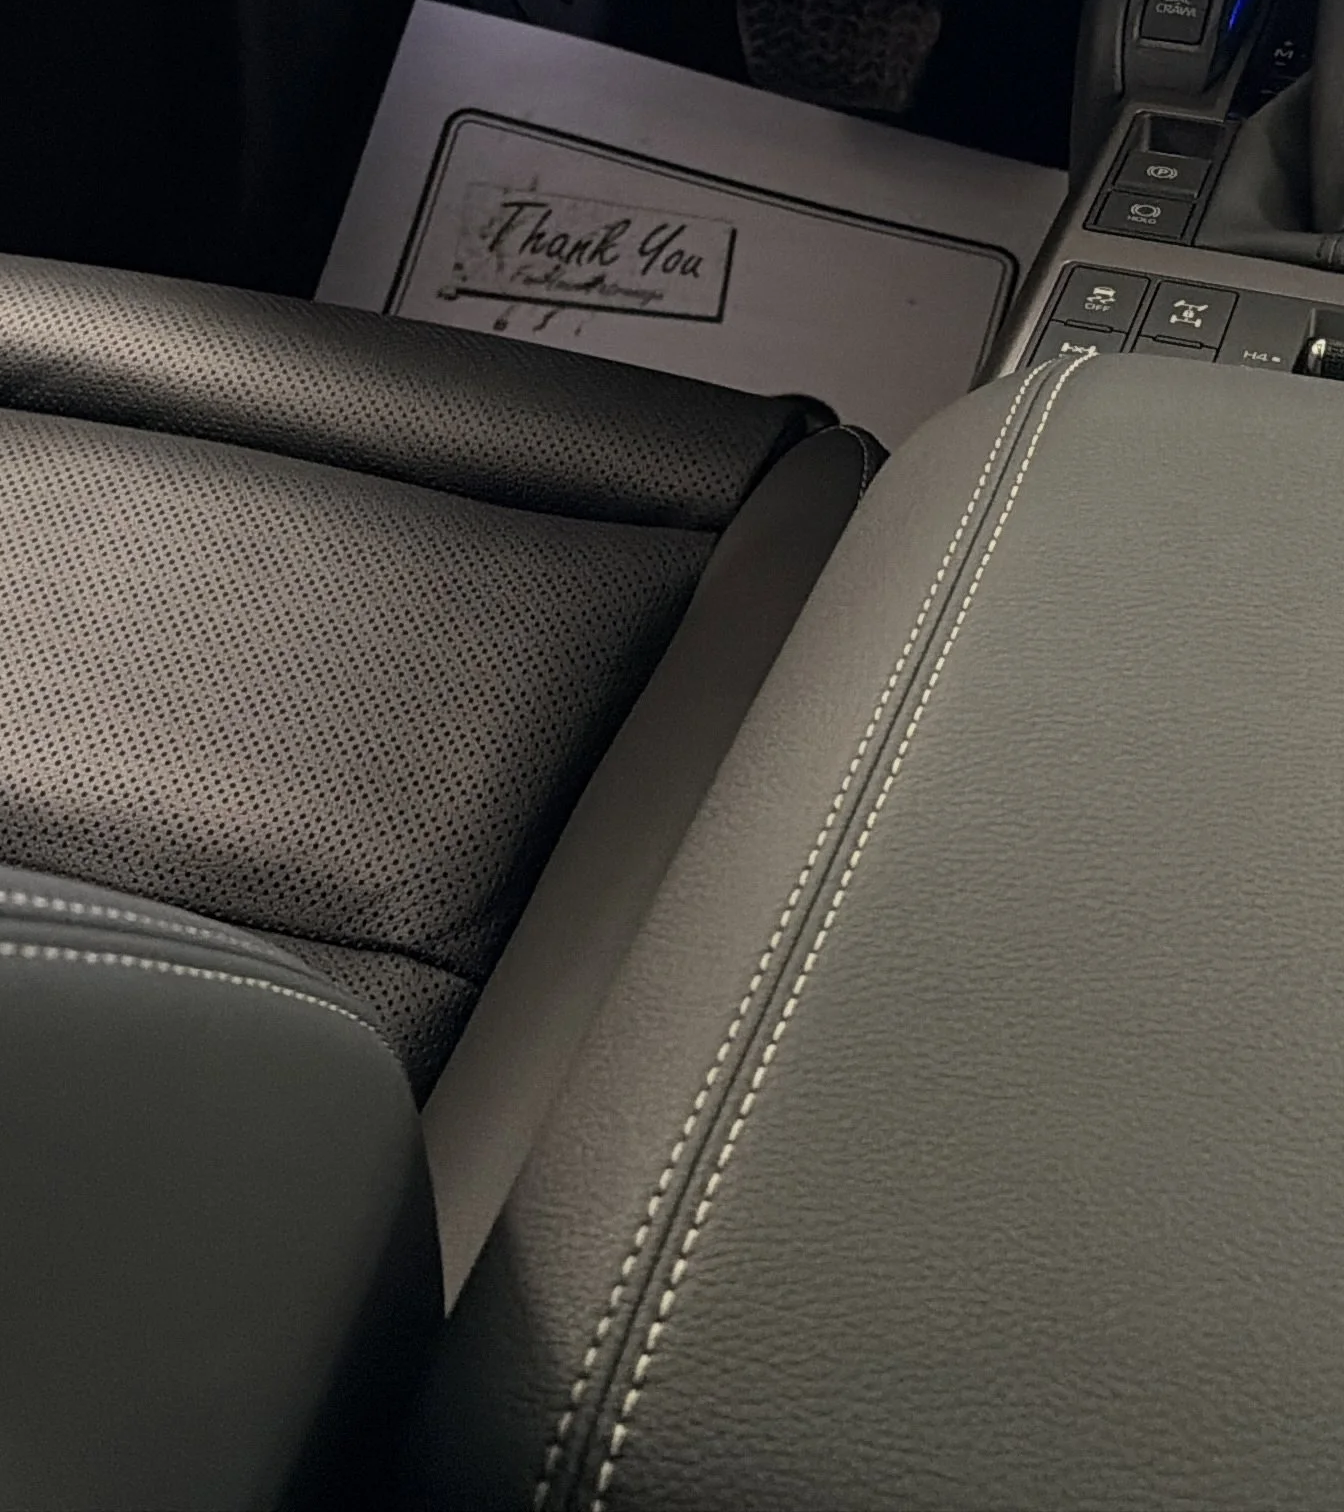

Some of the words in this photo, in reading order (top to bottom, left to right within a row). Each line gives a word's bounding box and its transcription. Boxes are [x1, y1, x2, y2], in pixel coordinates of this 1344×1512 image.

[488, 200, 632, 268] Thank
[637, 223, 703, 279] You
[1084, 301, 1112, 313] OFF
